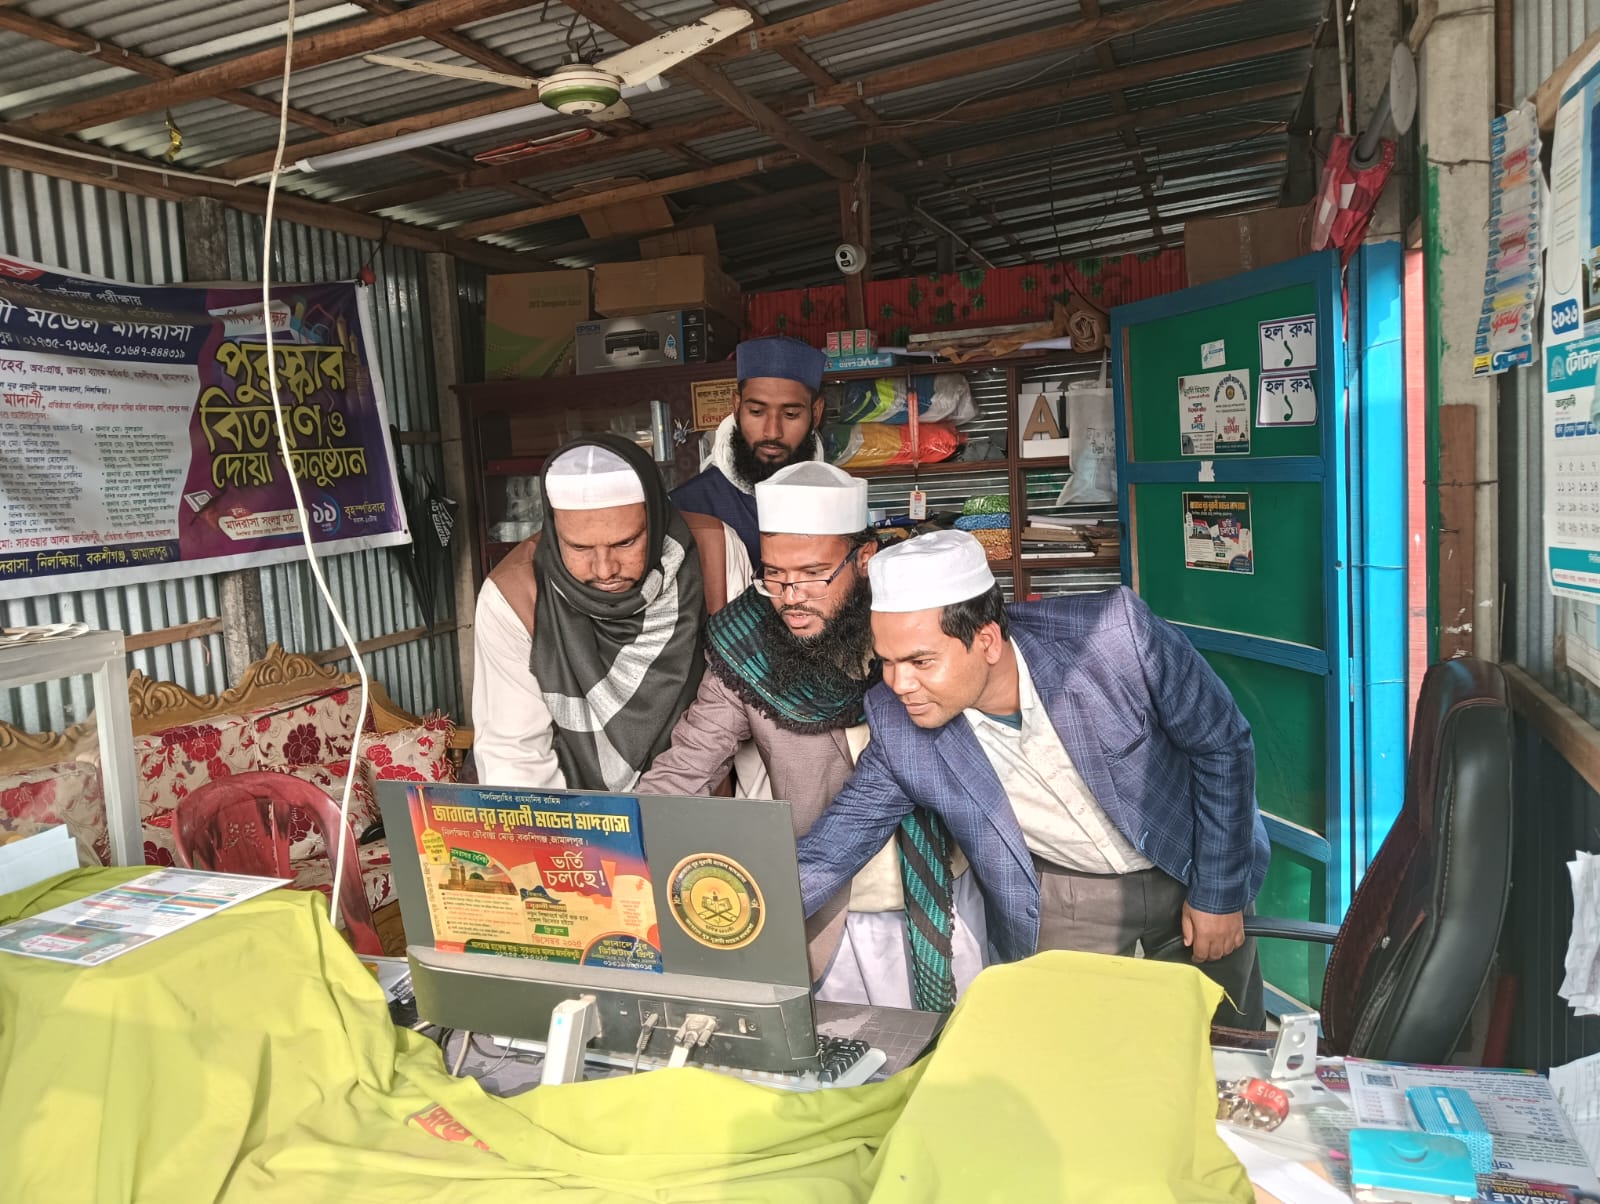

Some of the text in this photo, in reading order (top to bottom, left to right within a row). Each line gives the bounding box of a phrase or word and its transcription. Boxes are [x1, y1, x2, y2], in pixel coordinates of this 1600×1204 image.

[25, 306, 100, 335] মডেল
[107, 320, 195, 343] মাদরাসা
[1552, 304, 1578, 328] ২০২৬
[1262, 321, 1314, 341] হল রুম
[856, 356, 879, 367] PVC
[1283, 340, 1293, 367] ১
[215, 341, 345, 405] পুরস্কার
[1264, 380, 1286, 395] হল
[1290, 377, 1313, 394] রুম
[3, 390, 46, 411] মাদানী,
[1283, 395, 1293, 421] ১
[200, 387, 346, 453] বিতরণ ও
[212, 437, 368, 489] দোয়া অনুষ্ঠান
[224, 515, 259, 531] মাদরাসা
[282, 511, 295, 524] মাঠ
[312, 502, 337, 524] ১১
[49, 534, 70, 545] আলম
[36, 551, 83, 571] নিলক্ষিয়া,
[86, 546, 129, 565] বকশীগঞ্জ,
[543, 795, 561, 805] রাহিম
[431, 804, 631, 837] জাবালে নূর নূরানী মডেল মাদরাসা
[550, 851, 585, 871] ভর্তি
[543, 868, 607, 889] চলছে!
